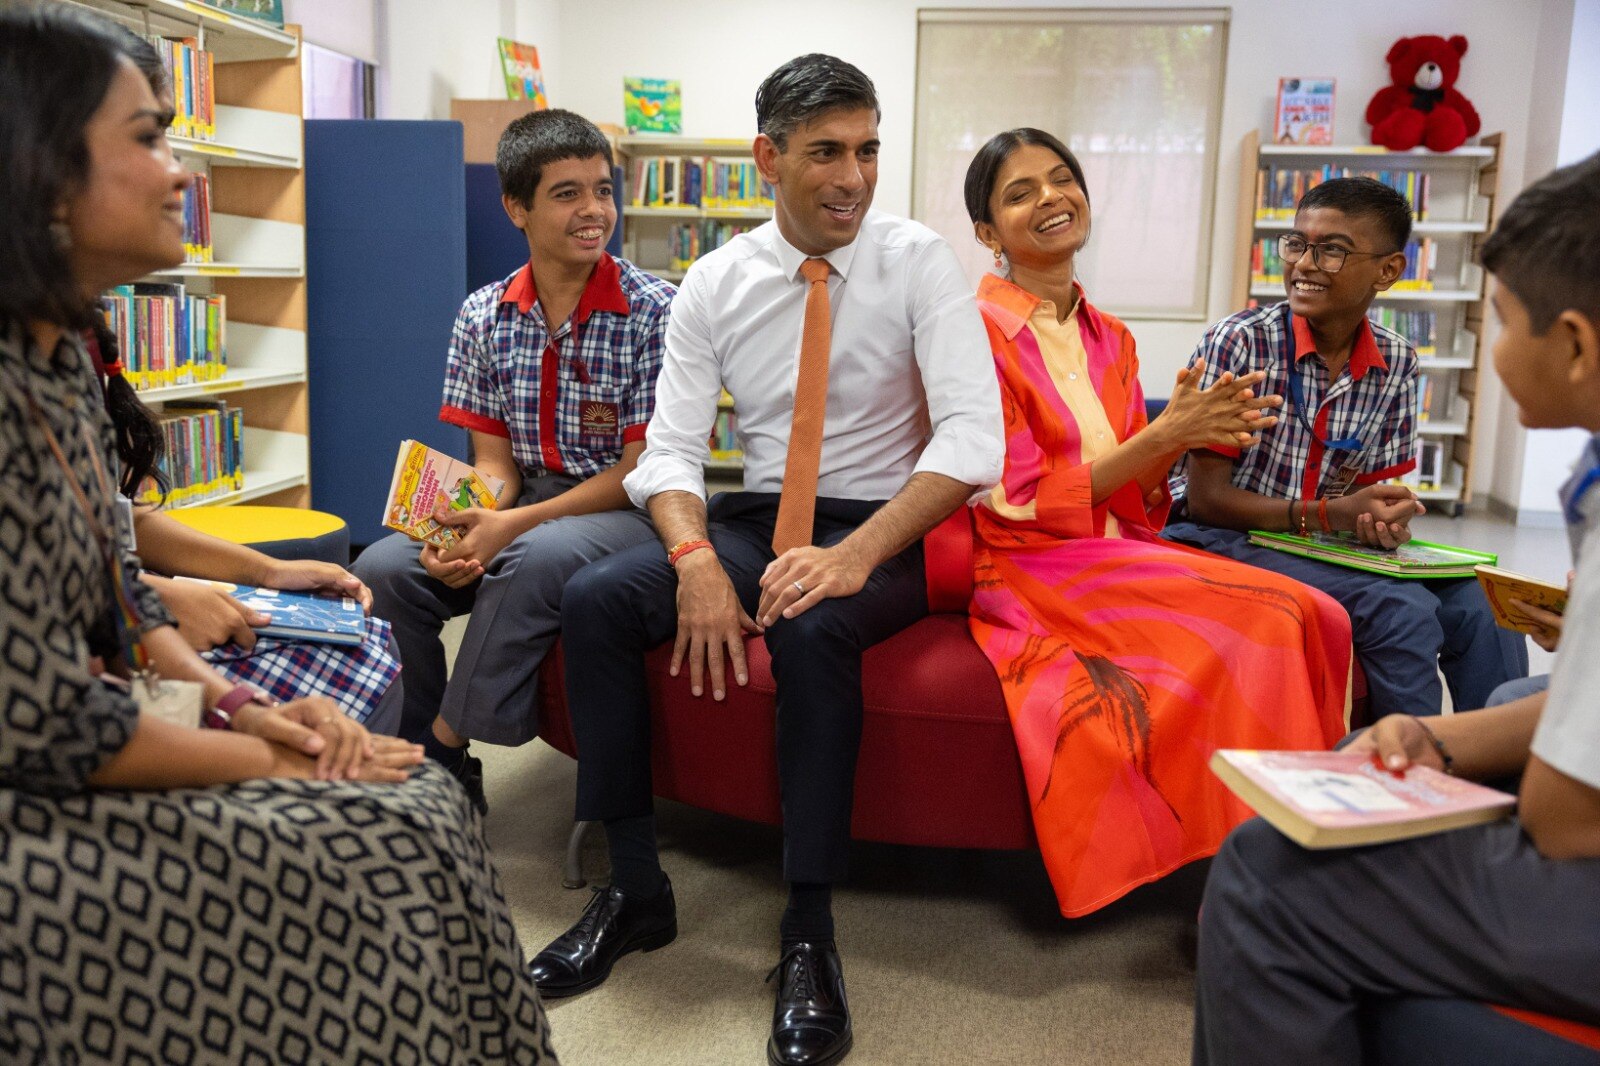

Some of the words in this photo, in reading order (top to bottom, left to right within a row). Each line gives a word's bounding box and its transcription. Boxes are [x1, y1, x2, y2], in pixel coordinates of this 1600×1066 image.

[400, 472, 413, 502] Geronimo
[410, 448, 421, 471] Stilton
[416, 469, 436, 519] GERONIMO
[425, 479, 440, 514] STILTON
